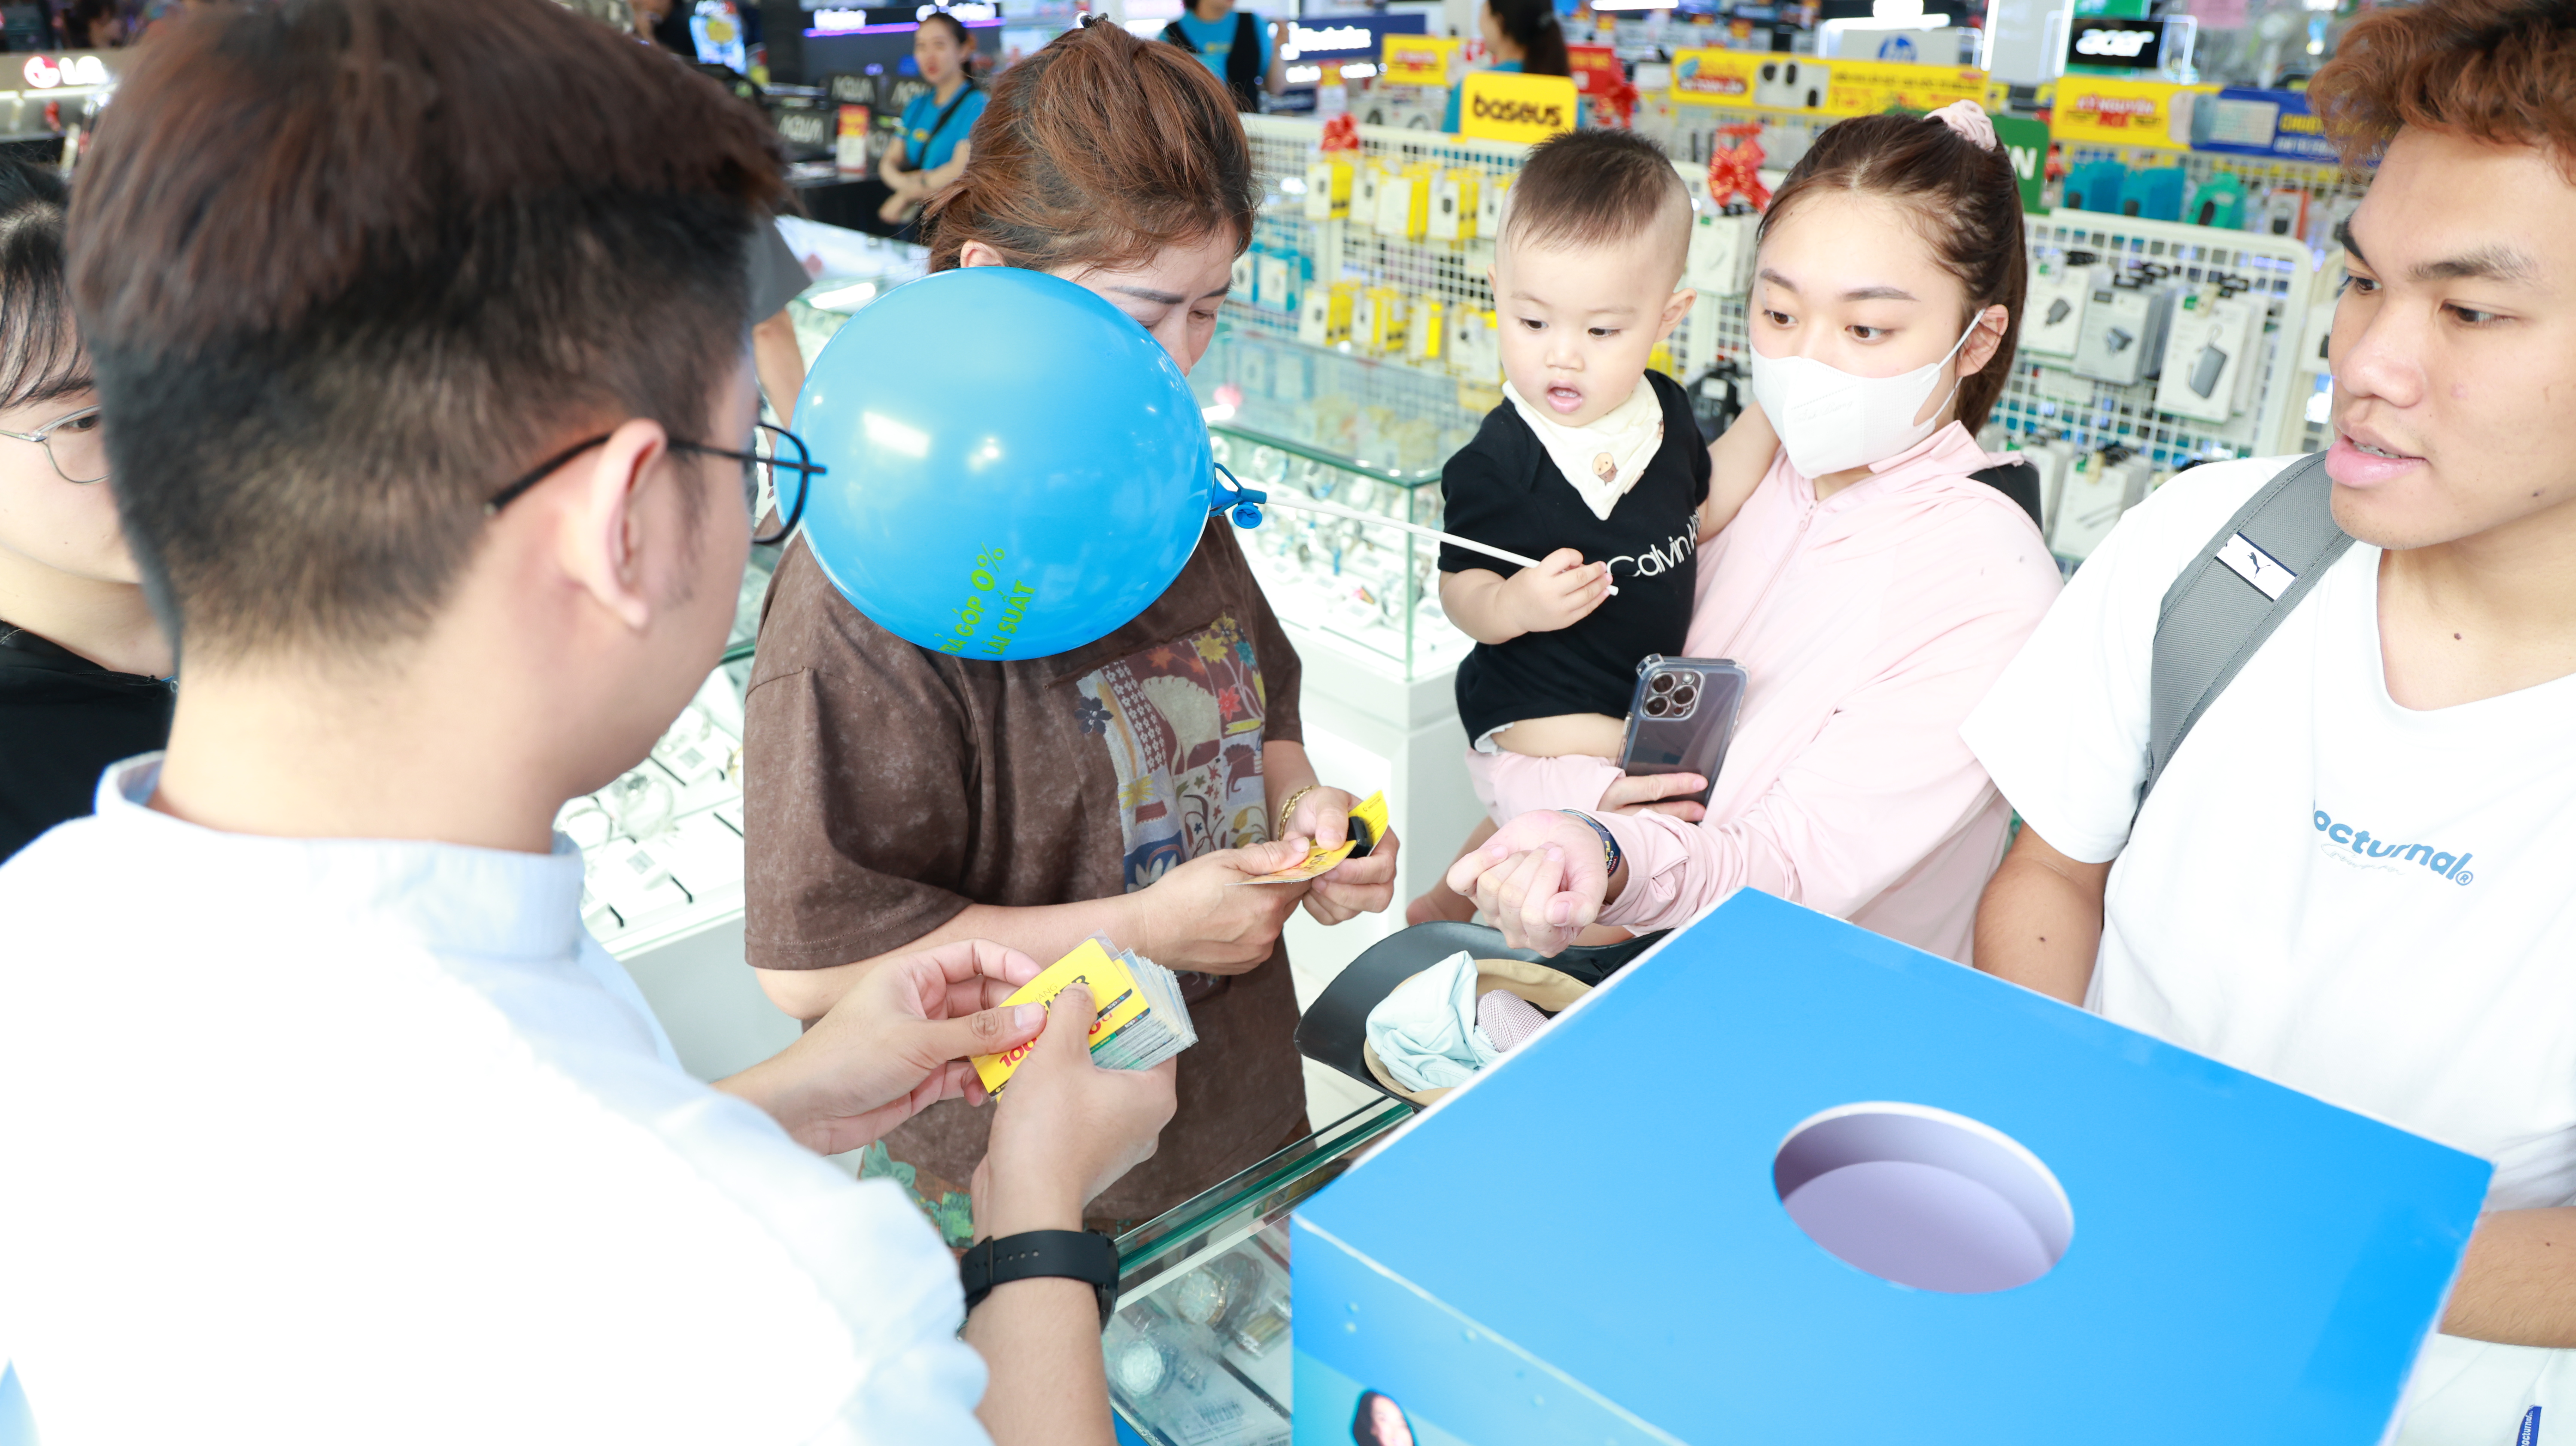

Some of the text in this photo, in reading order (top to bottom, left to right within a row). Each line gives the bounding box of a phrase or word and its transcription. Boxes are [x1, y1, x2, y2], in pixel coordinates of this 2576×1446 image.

[2076, 29, 2155, 57] acer
[1473, 93, 1562, 127] baseus
[1606, 536, 1692, 577] Calvin
[951, 595, 985, 637] GÓP
[970, 541, 1005, 591] 0%
[997, 579, 1036, 634] SUẤT
[2313, 807, 2474, 886] octurnal®
[2521, 1414, 2533, 1446] octurnal
